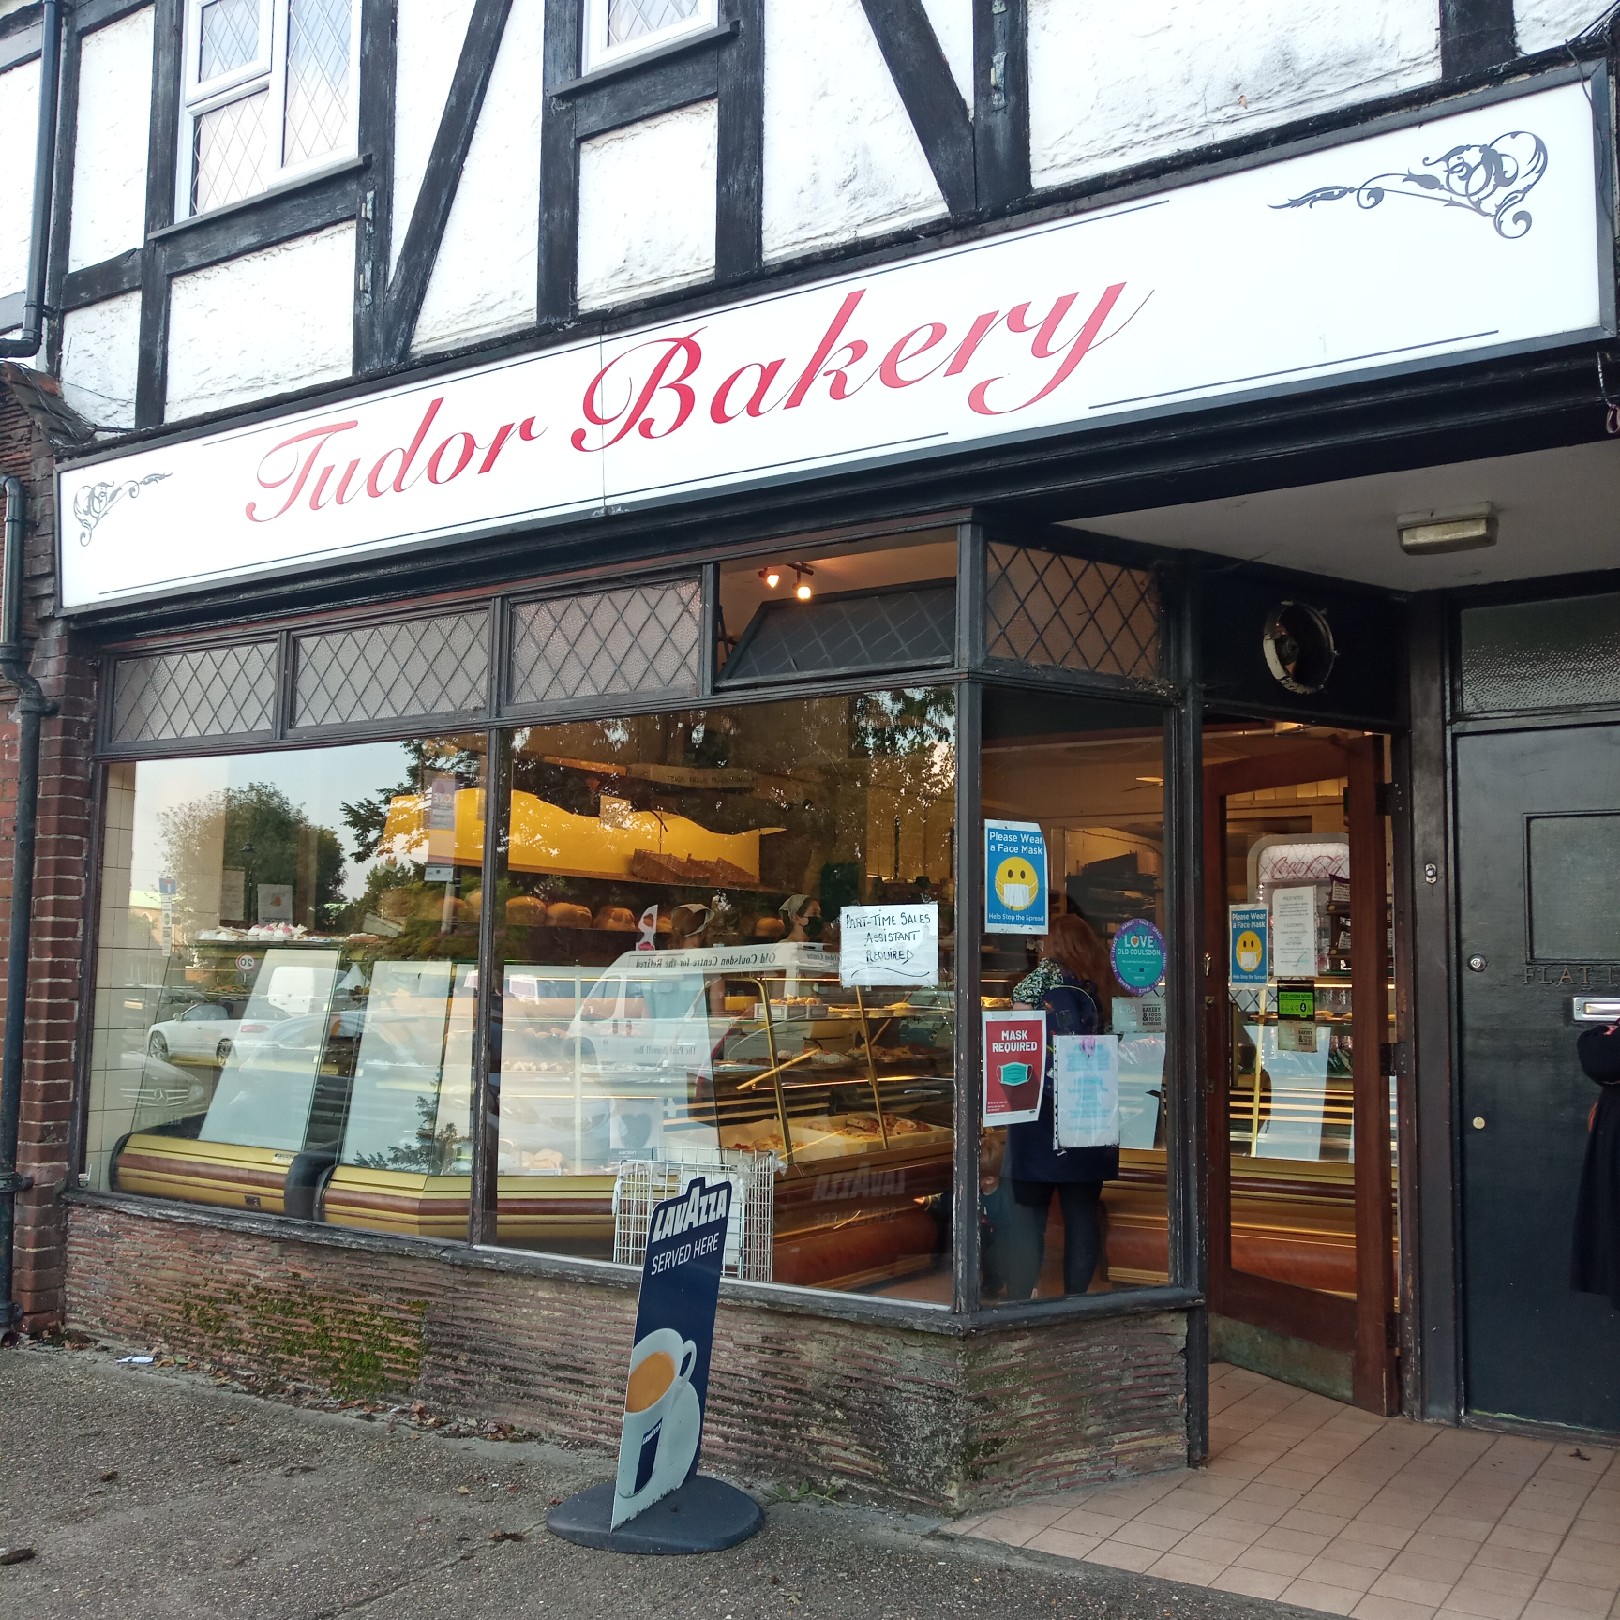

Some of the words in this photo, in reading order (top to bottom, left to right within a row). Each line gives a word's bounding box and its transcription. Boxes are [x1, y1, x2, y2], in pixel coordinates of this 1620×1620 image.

[245, 396, 549, 523] Tudor
[571, 282, 1155, 453] Bakery
[989, 831, 1018, 843] Please
[1020, 833, 1044, 845] Wear
[990, 844, 996, 852] a
[997, 843, 1019, 854] Face
[1021, 845, 1043, 856] Mask
[846, 909, 897, 929] PART-TIME
[900, 912, 931, 926] SALES
[1002, 913, 1015, 922] Stop
[1025, 914, 1044, 923] Spread
[1232, 913, 1250, 921] Please
[1250, 912, 1267, 920] Wear
[864, 929, 921, 943] ASSISTANT
[1124, 934, 1154, 949] LOVE
[866, 947, 915, 965] REQUIRED
[1130, 948, 1161, 956] COULSDON
[1522, 965, 1593, 985] FLAT
[1001, 1029, 1028, 1041] MASK
[992, 1042, 1038, 1053] REQUIRED
[651, 1186, 728, 1244] LAVAZZA
[650, 1243, 692, 1276] SERVED
[693, 1232, 720, 1259] HERE
